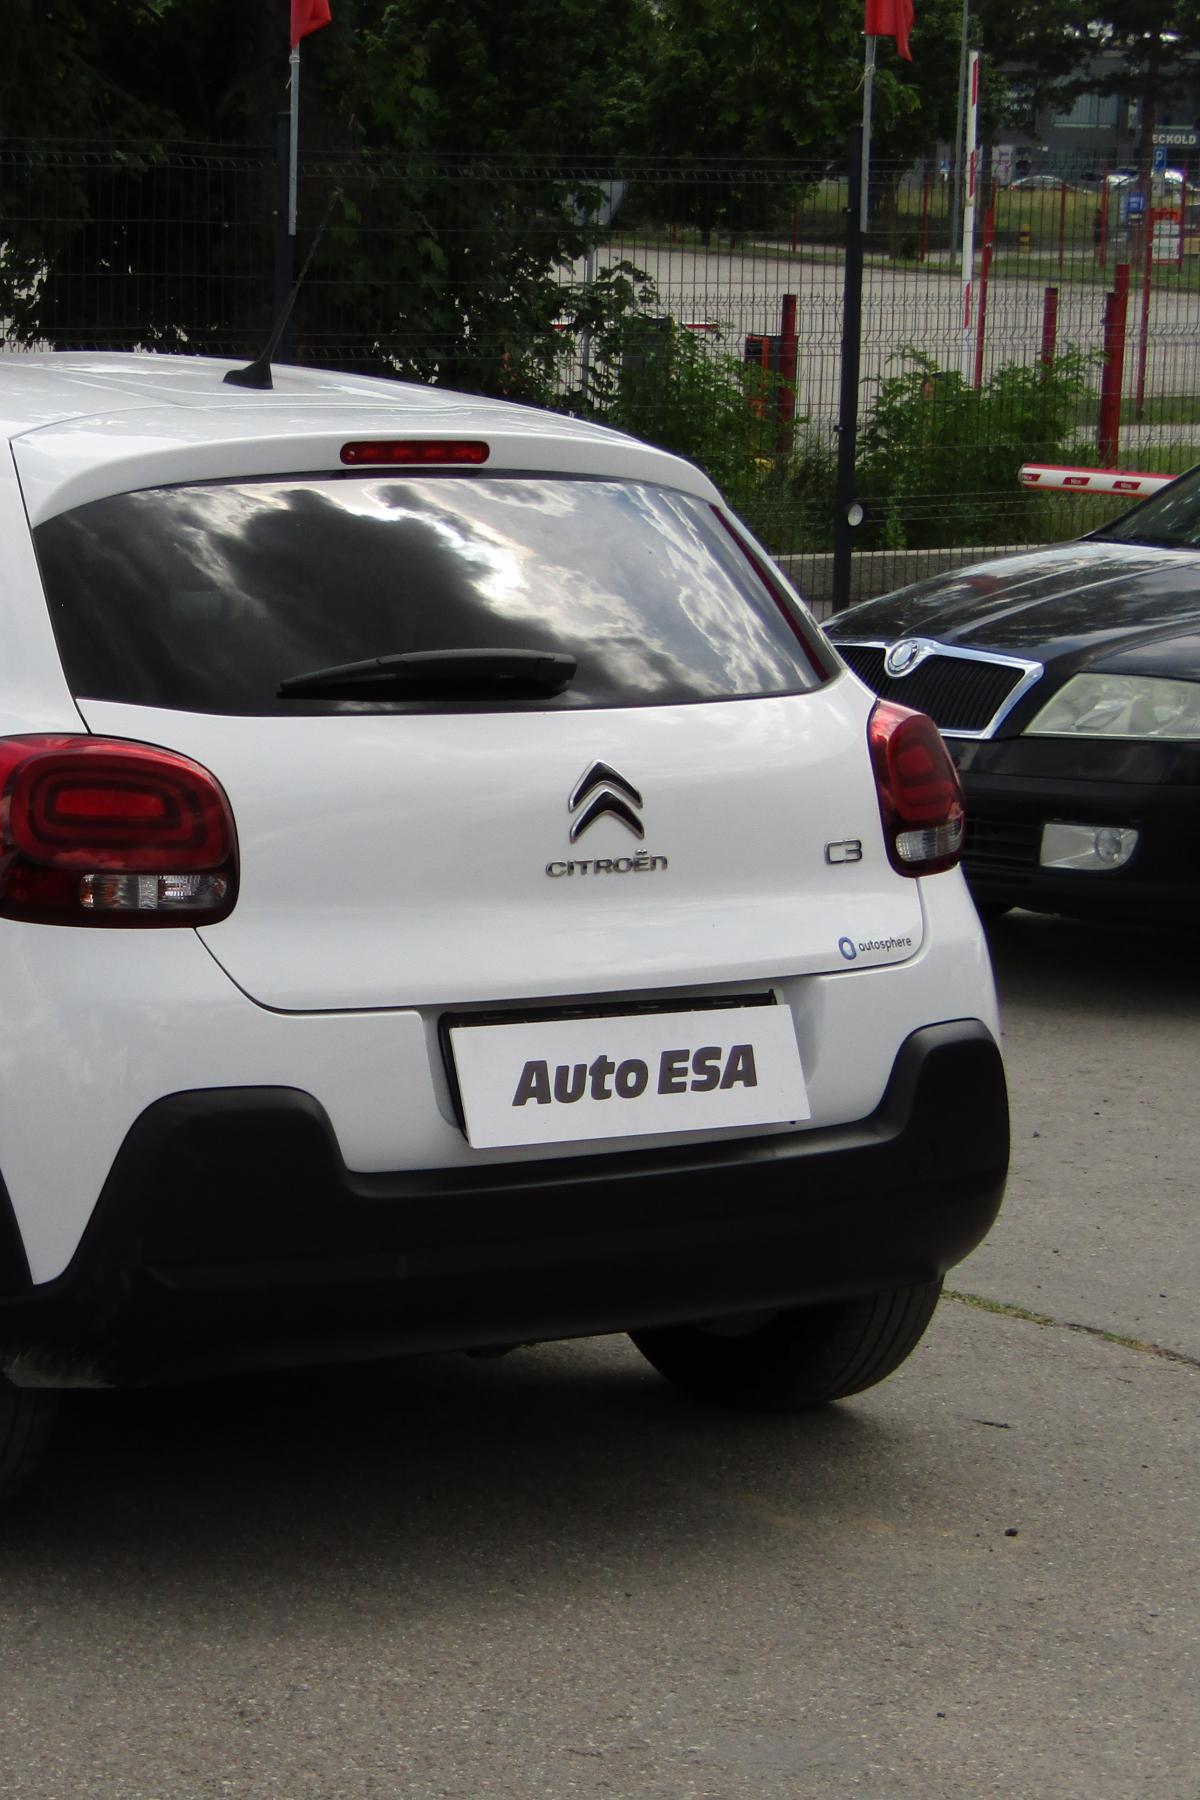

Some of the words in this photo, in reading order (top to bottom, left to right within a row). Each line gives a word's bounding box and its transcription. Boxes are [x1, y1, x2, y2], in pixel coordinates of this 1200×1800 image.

[1152, 134, 1197, 145] ECKOLD
[823, 838, 863, 866] C3
[858, 937, 913, 953] autosphere
[511, 1054, 649, 1107] Auto
[657, 1043, 758, 1095] ESA
